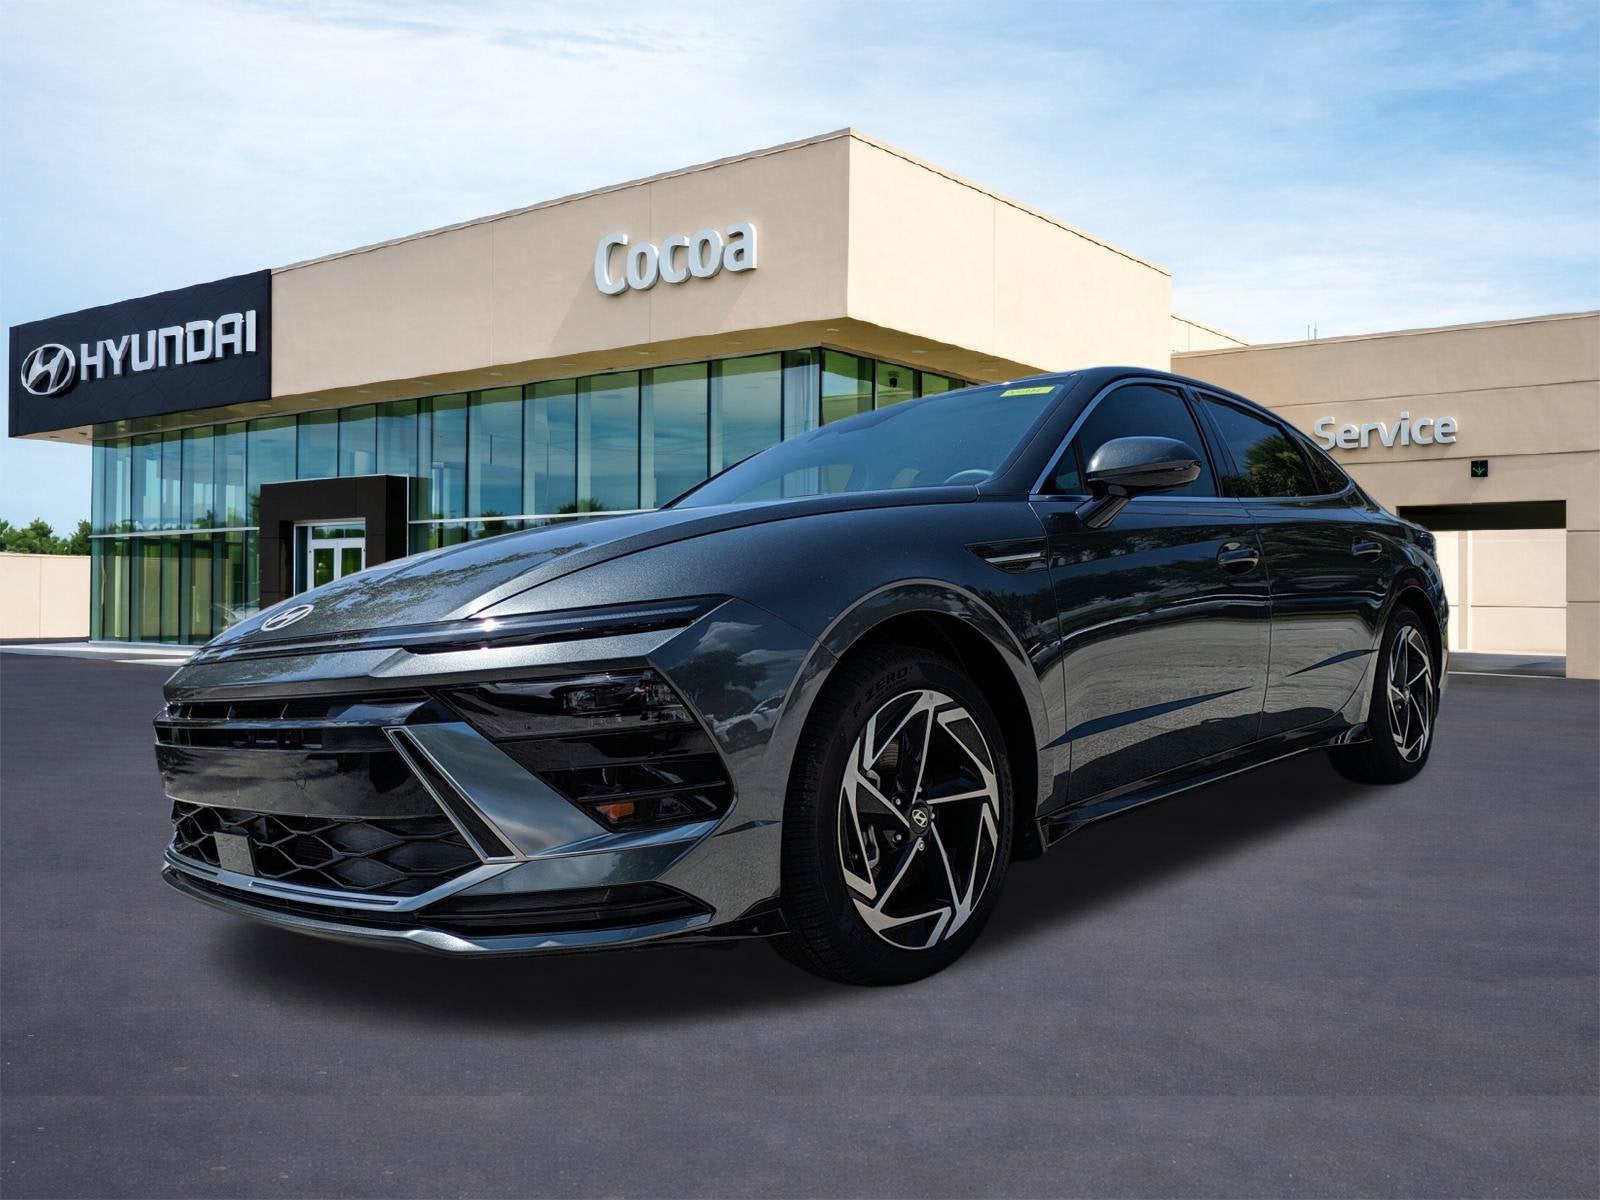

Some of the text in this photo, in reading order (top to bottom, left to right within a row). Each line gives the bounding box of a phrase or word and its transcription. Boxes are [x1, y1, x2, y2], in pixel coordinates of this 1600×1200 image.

[594, 222, 757, 296] Cocoa
[79, 309, 257, 381] HYUNDAI
[1314, 410, 1458, 451] Service
